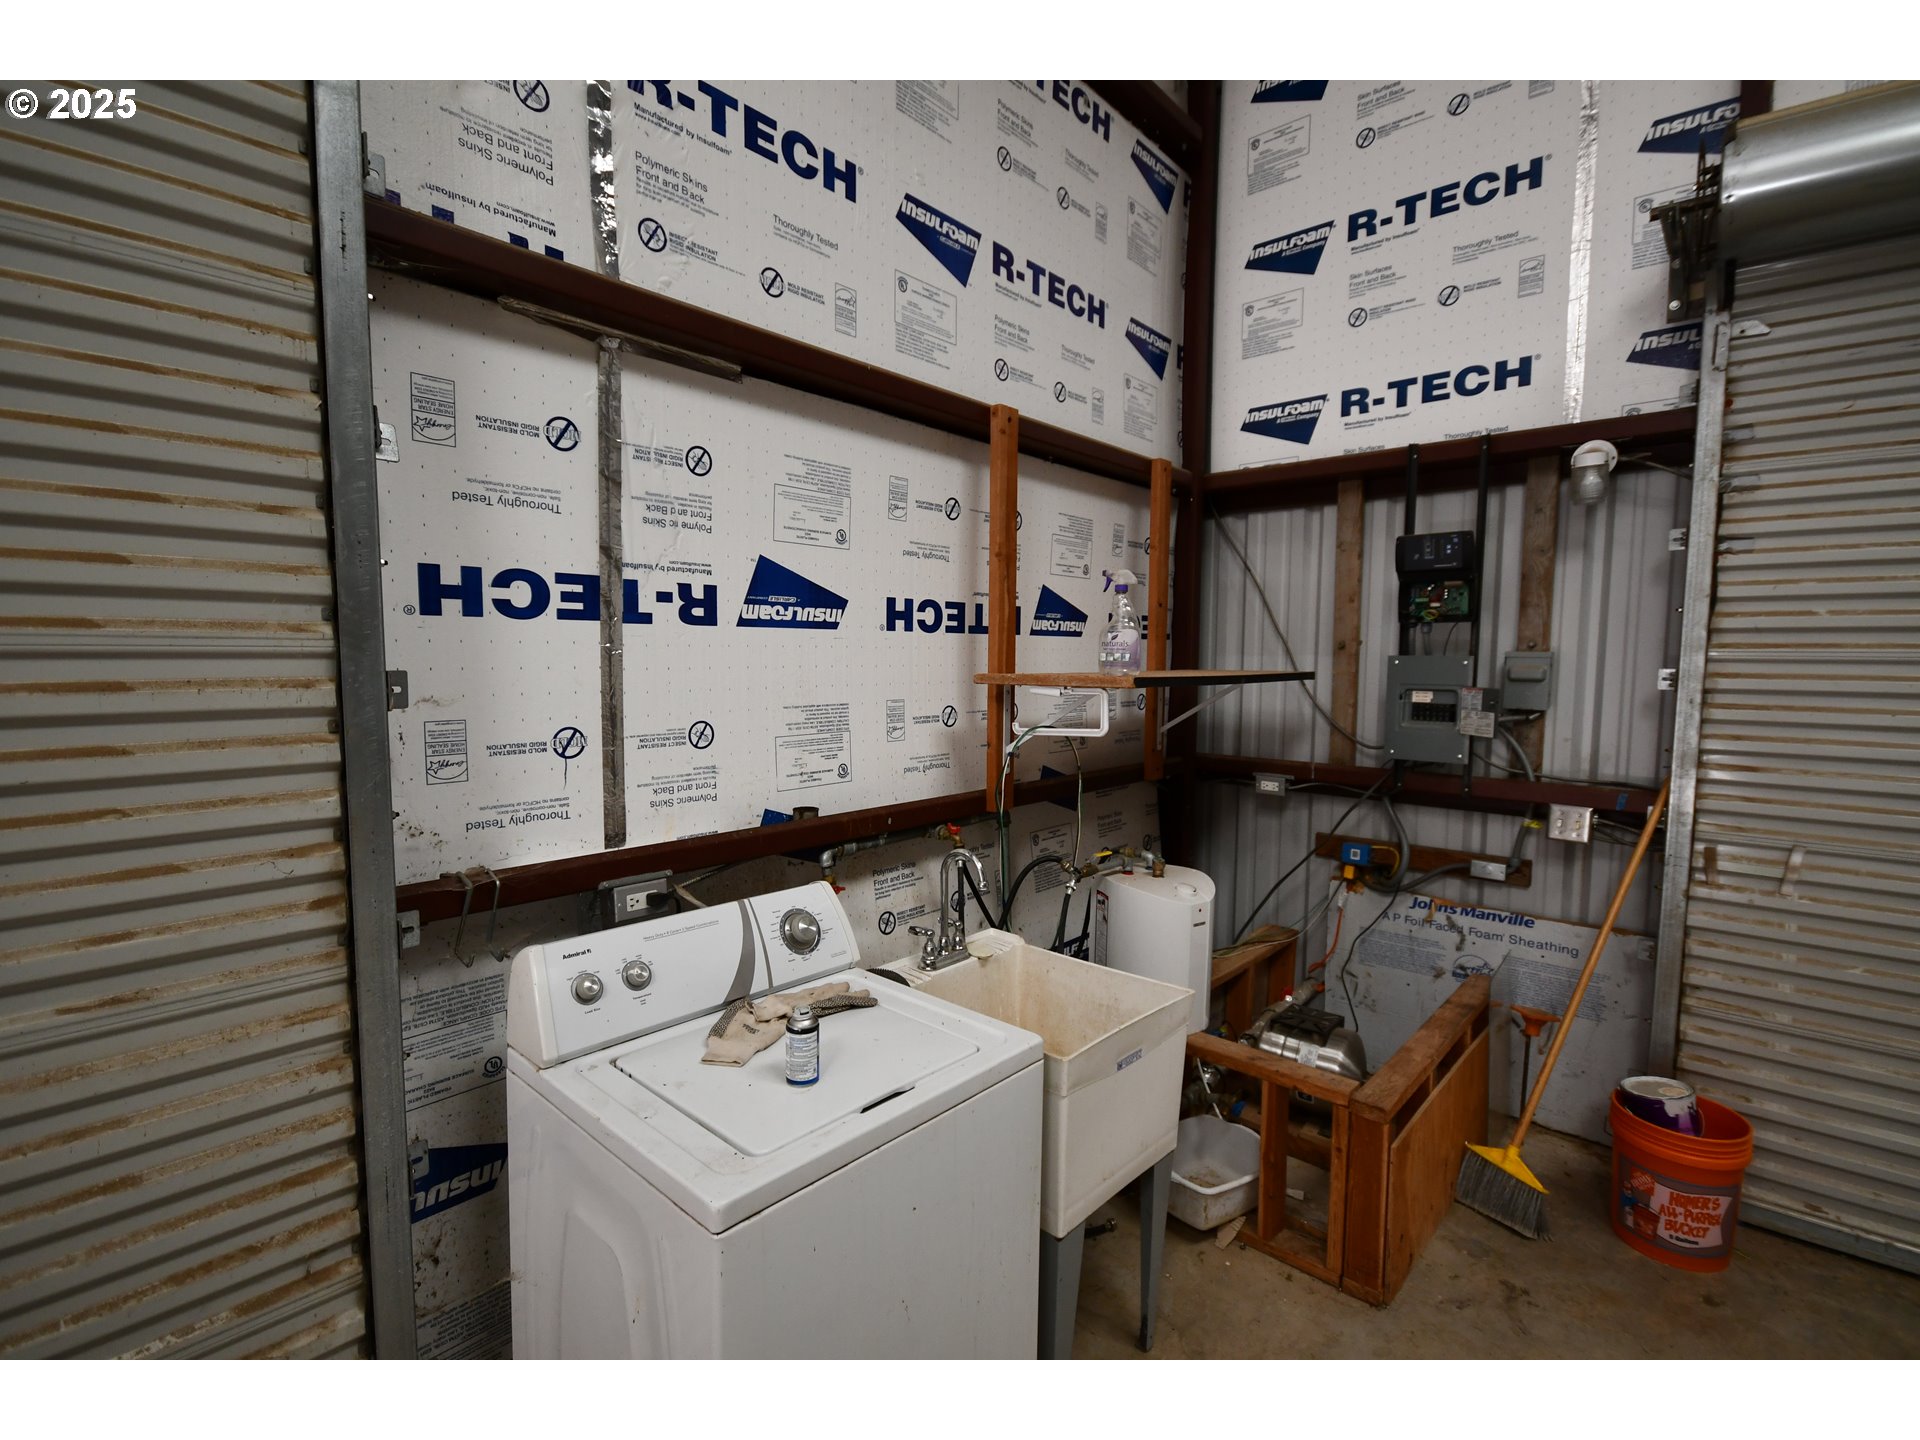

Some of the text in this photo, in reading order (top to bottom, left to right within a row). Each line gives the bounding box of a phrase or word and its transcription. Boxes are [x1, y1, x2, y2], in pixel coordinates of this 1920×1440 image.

[634, 102, 683, 132] Manufactured
[686, 129, 694, 139] by
[461, 123, 553, 171] Front and Back
[458, 138, 553, 186] Polymeric Skins
[635, 150, 708, 192] Polymeric Skins
[636, 165, 660, 184] Front
[662, 178, 679, 192] and
[682, 185, 705, 205] Back
[479, 201, 490, 214] by
[493, 207, 557, 238] Manufactured
[773, 213, 838, 251] Thoroughly Tested
[1452, 230, 1519, 253] Thoroughly Tested
[1349, 264, 1392, 281] Skin Surfaces
[1349, 271, 1397, 289] Front and Back
[475, 414, 540, 432] RIGID INSULATION
[477, 421, 540, 439] MOLD RESISTANT
[1444, 425, 1509, 440] Thoroughly Tested
[668, 454, 683, 462] RIGID
[1343, 444, 1385, 455] Skin Surfaces
[664, 460, 683, 468] INSECT
[452, 491, 562, 515] Thoroughly Tested
[640, 504, 712, 521] Front and Back
[637, 516, 712, 534] Polymeric Skins
[902, 550, 950, 563] Thoroughly Tested
[654, 563, 712, 576] Manufactured by
[1101, 640, 1129, 648] naturals
[486, 742, 528, 751] INSULATION
[488, 749, 527, 757] RESISTANT
[636, 741, 667, 750] RESISTANT
[904, 762, 951, 775] Thoroughly Tested
[652, 781, 717, 796] Front and Back
[649, 792, 718, 809] Polymeric Skins
[465, 810, 571, 833] Thoroughly Tested
[873, 861, 916, 877] Polymeric Skins
[873, 871, 915, 886] Front and Back
[1459, 906, 1536, 929] Manville
[562, 949, 587, 960] Admiral
[1508, 934, 1579, 959] Sheathing
[1668, 1191, 1721, 1212] HOMER'S
[1664, 1219, 1711, 1239] BUCKET
